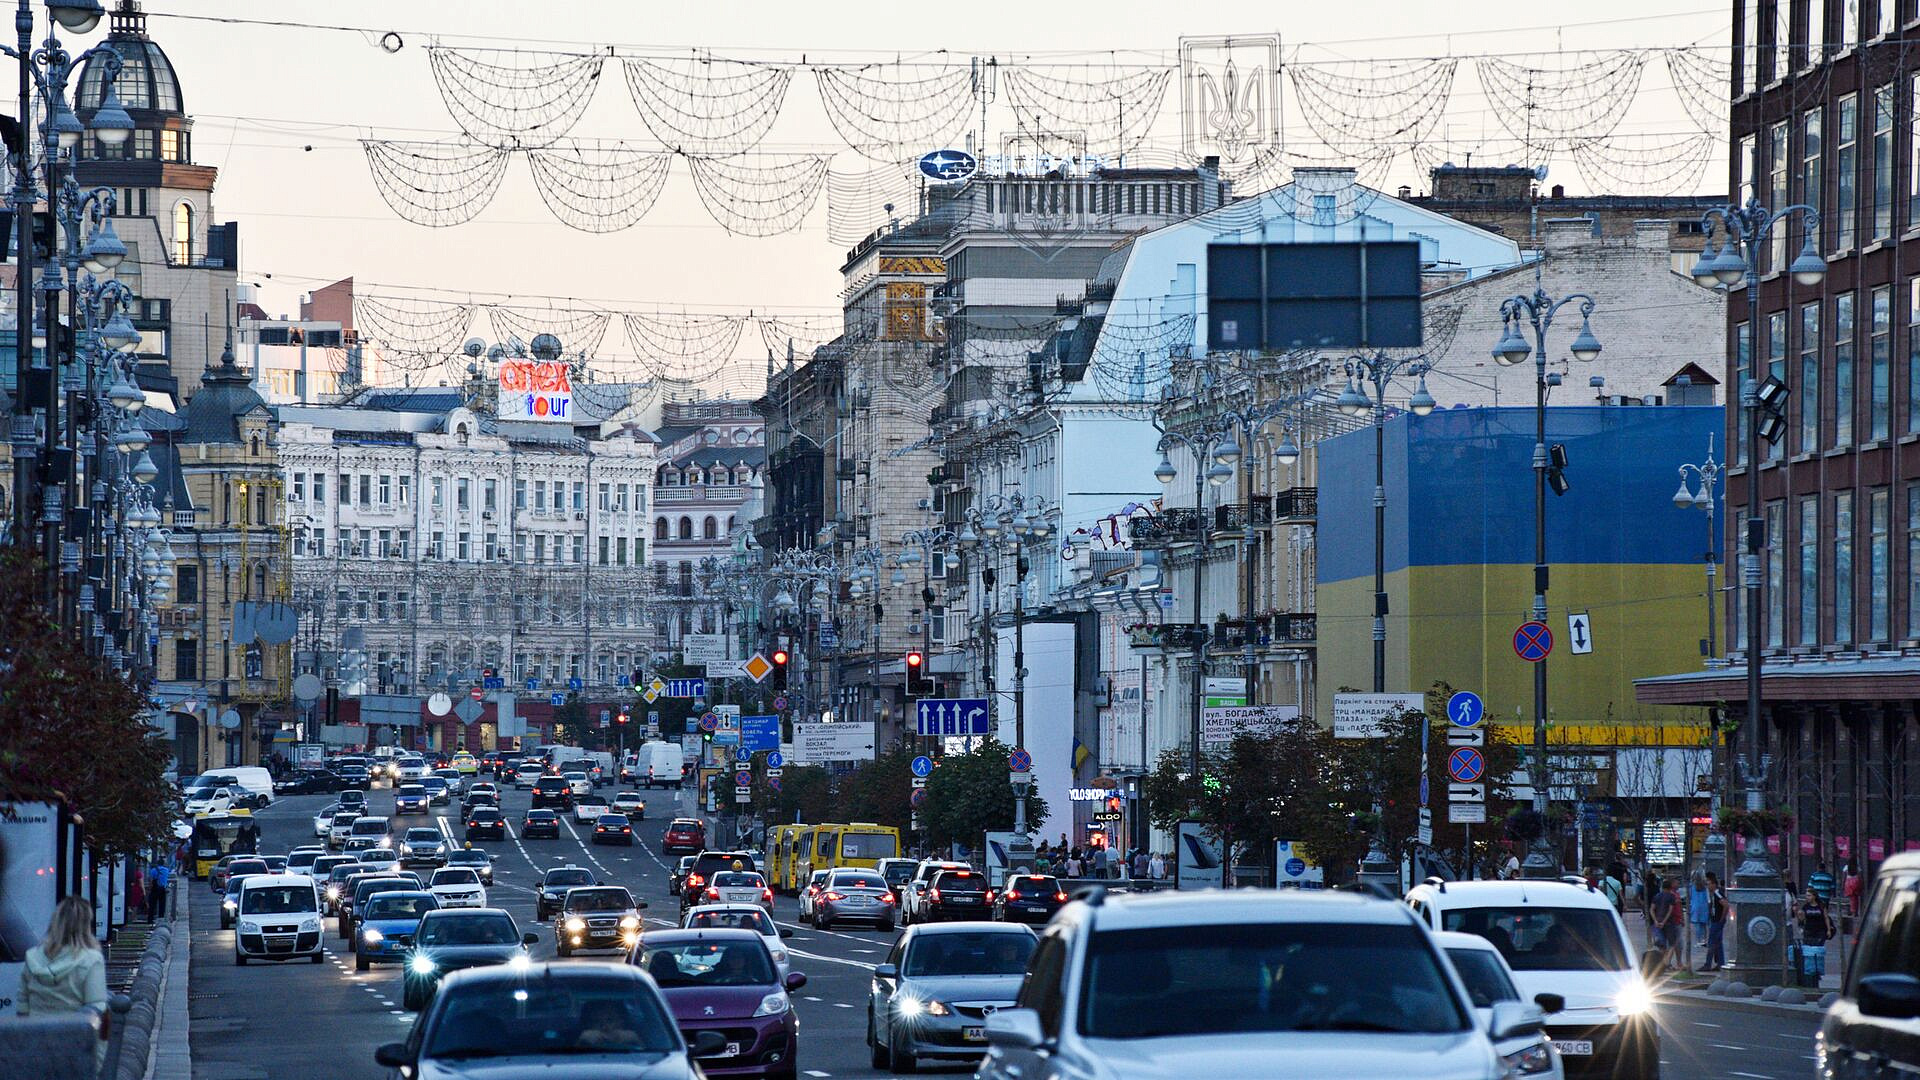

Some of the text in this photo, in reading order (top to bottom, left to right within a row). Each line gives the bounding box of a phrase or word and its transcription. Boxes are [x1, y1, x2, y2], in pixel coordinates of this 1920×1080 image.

[500, 361, 571, 392] anex
[527, 394, 569, 418] tour
[1225, 709, 1265, 717] БОГДАНА
[1205, 717, 1281, 726] ХМЕЛЬНИЦЬКОГО
[1069, 788, 1085, 800] YOLO
